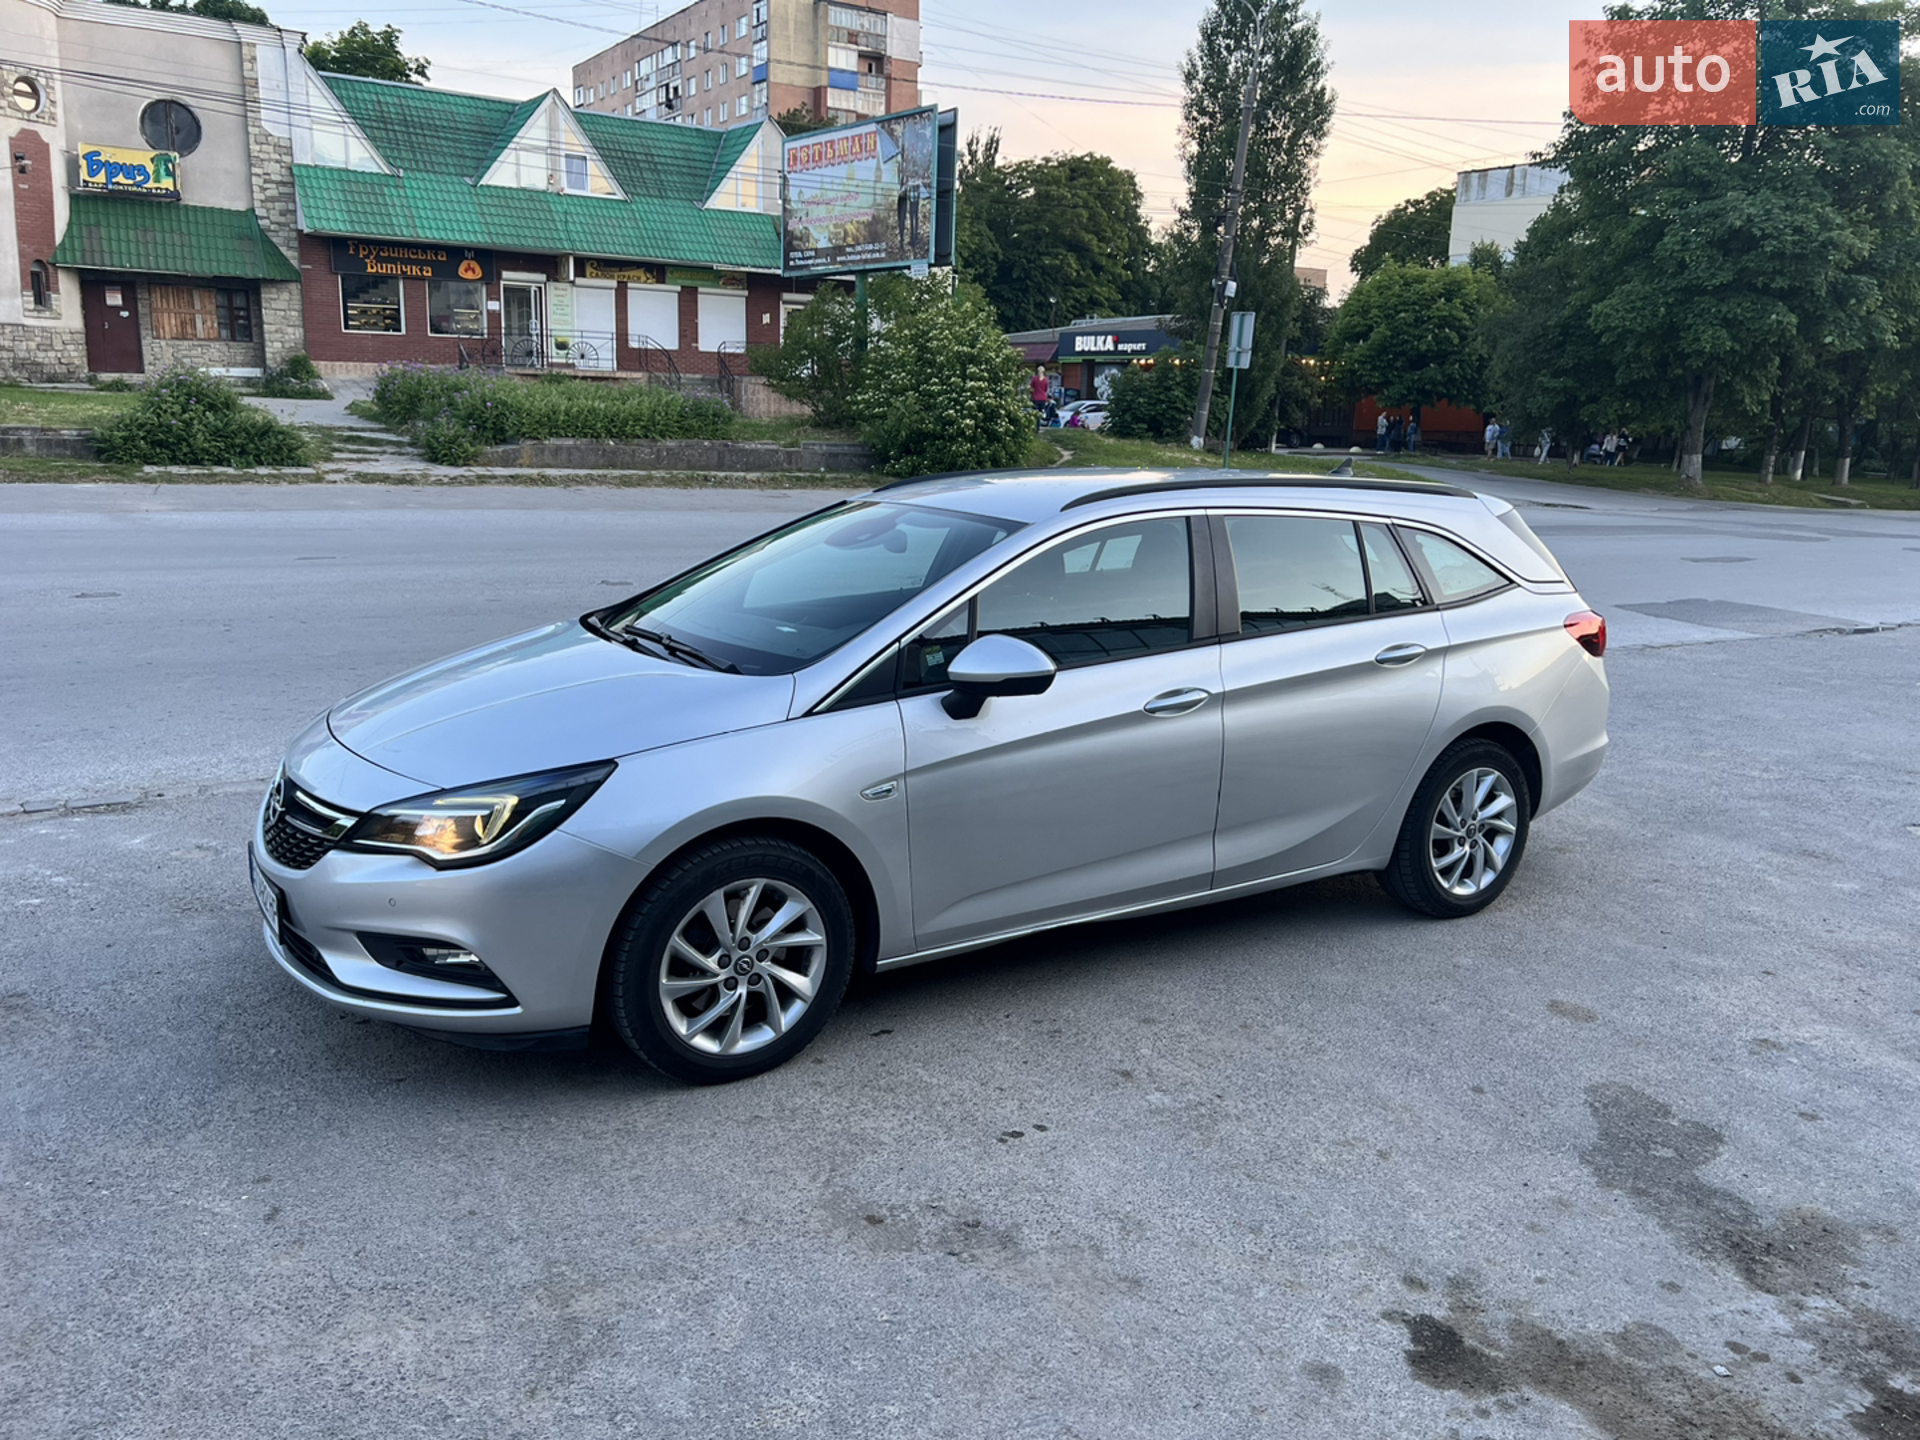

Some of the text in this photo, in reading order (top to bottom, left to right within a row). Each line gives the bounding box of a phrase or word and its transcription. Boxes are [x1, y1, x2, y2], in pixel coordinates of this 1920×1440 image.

[82, 150, 150, 187] Бриз
[347, 240, 447, 261] Грузинська
[365, 259, 433, 277] Випічка
[1074, 335, 1115, 352] BULKA
